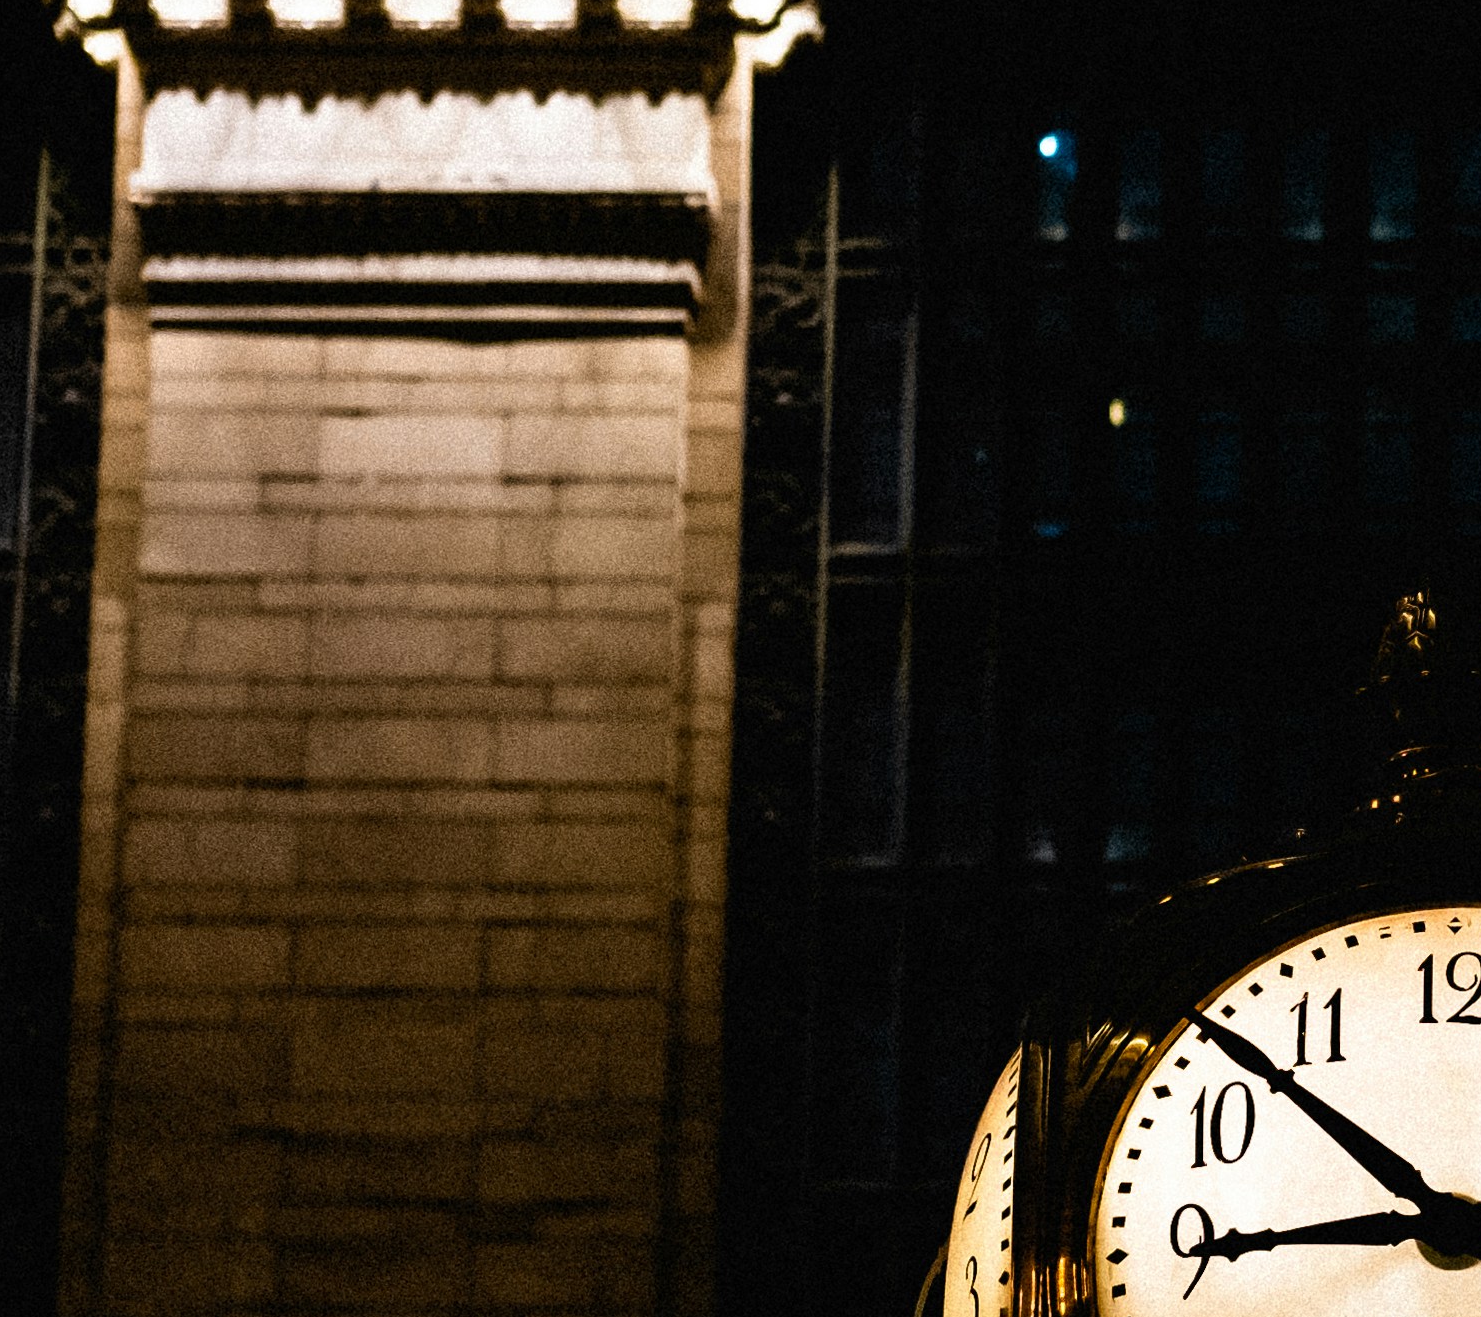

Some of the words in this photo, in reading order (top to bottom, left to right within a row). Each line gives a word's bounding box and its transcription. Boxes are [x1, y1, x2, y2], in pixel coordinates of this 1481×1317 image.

[1289, 986, 1348, 1069] 11
[1189, 1081, 1257, 1170] 10
[1169, 1203, 1213, 1301] 9
